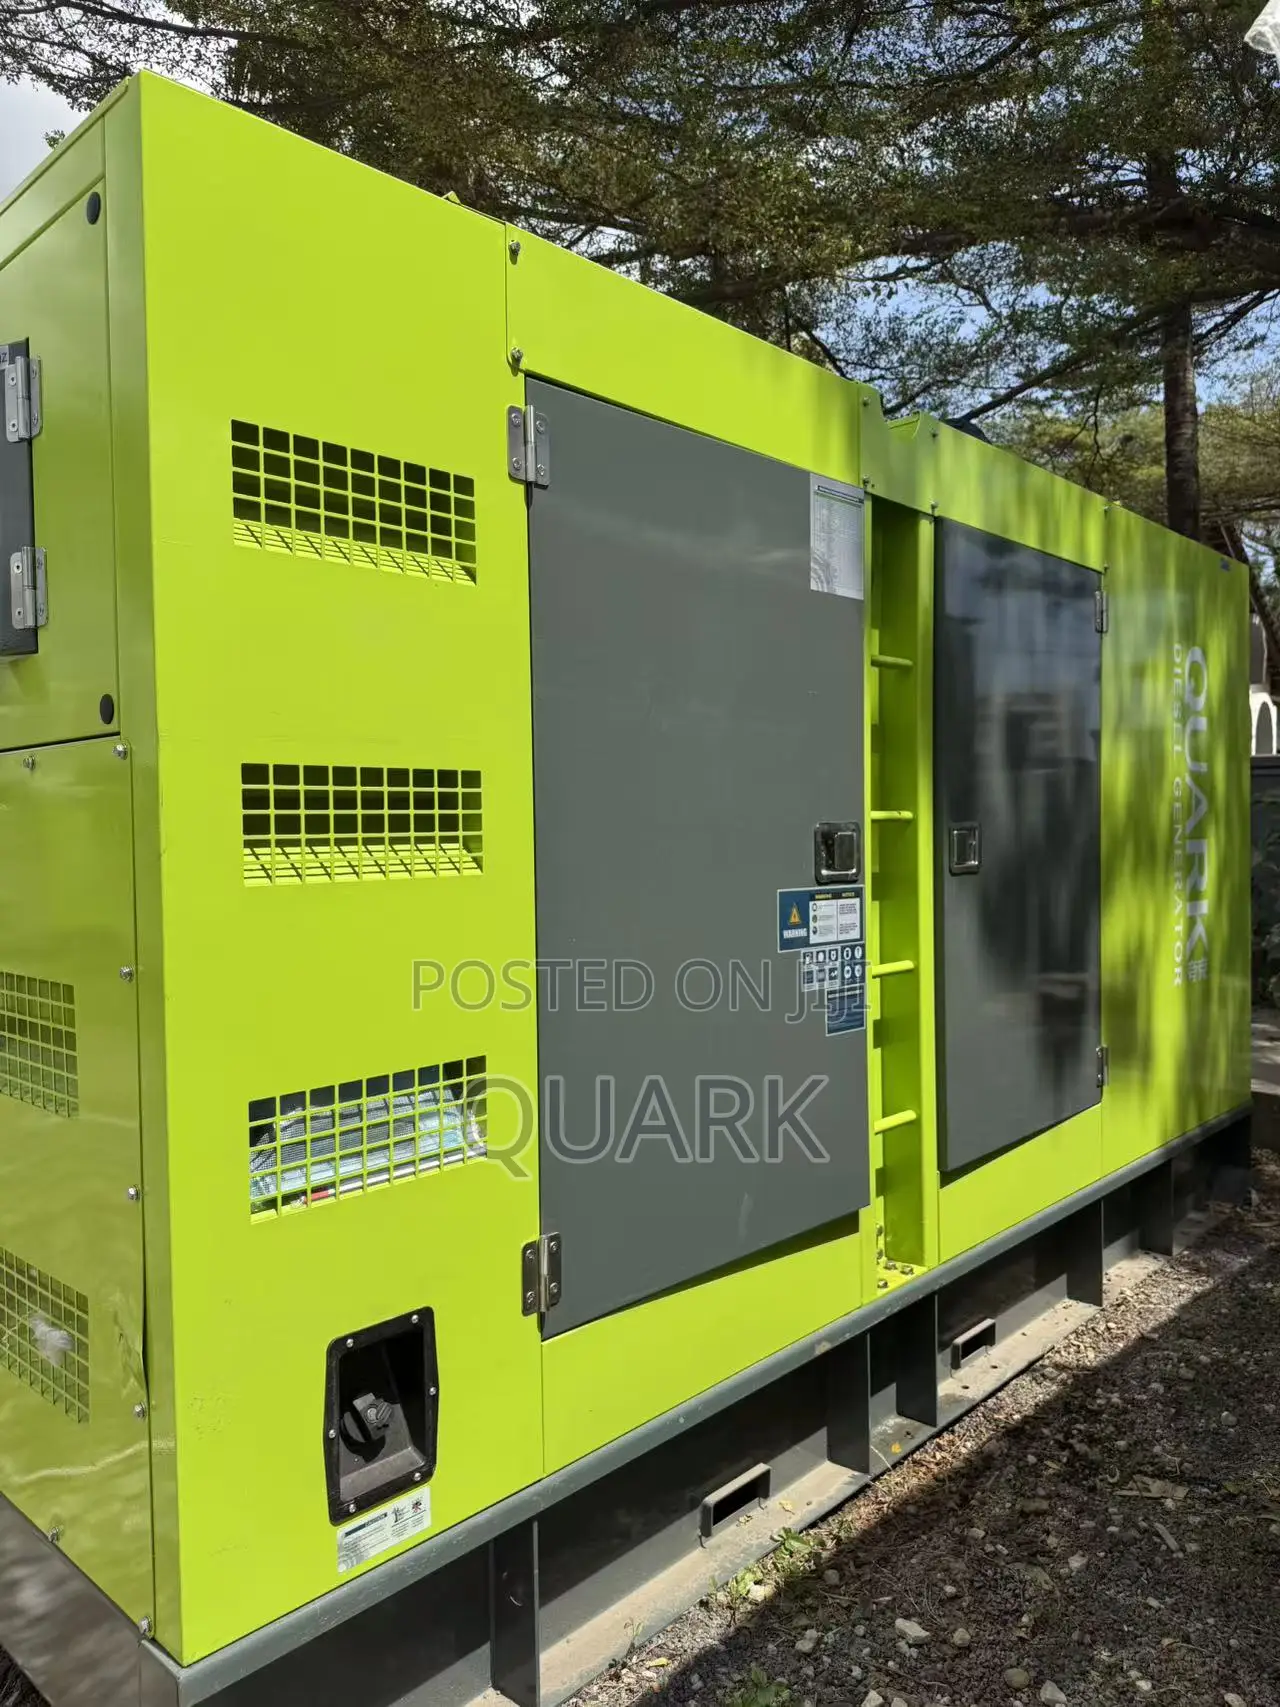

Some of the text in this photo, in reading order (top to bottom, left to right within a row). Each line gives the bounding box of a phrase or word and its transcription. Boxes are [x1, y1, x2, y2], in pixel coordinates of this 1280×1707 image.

[1173, 643, 1183, 986] DIESEL GENERATOR
[1185, 646, 1208, 960] QUARK
